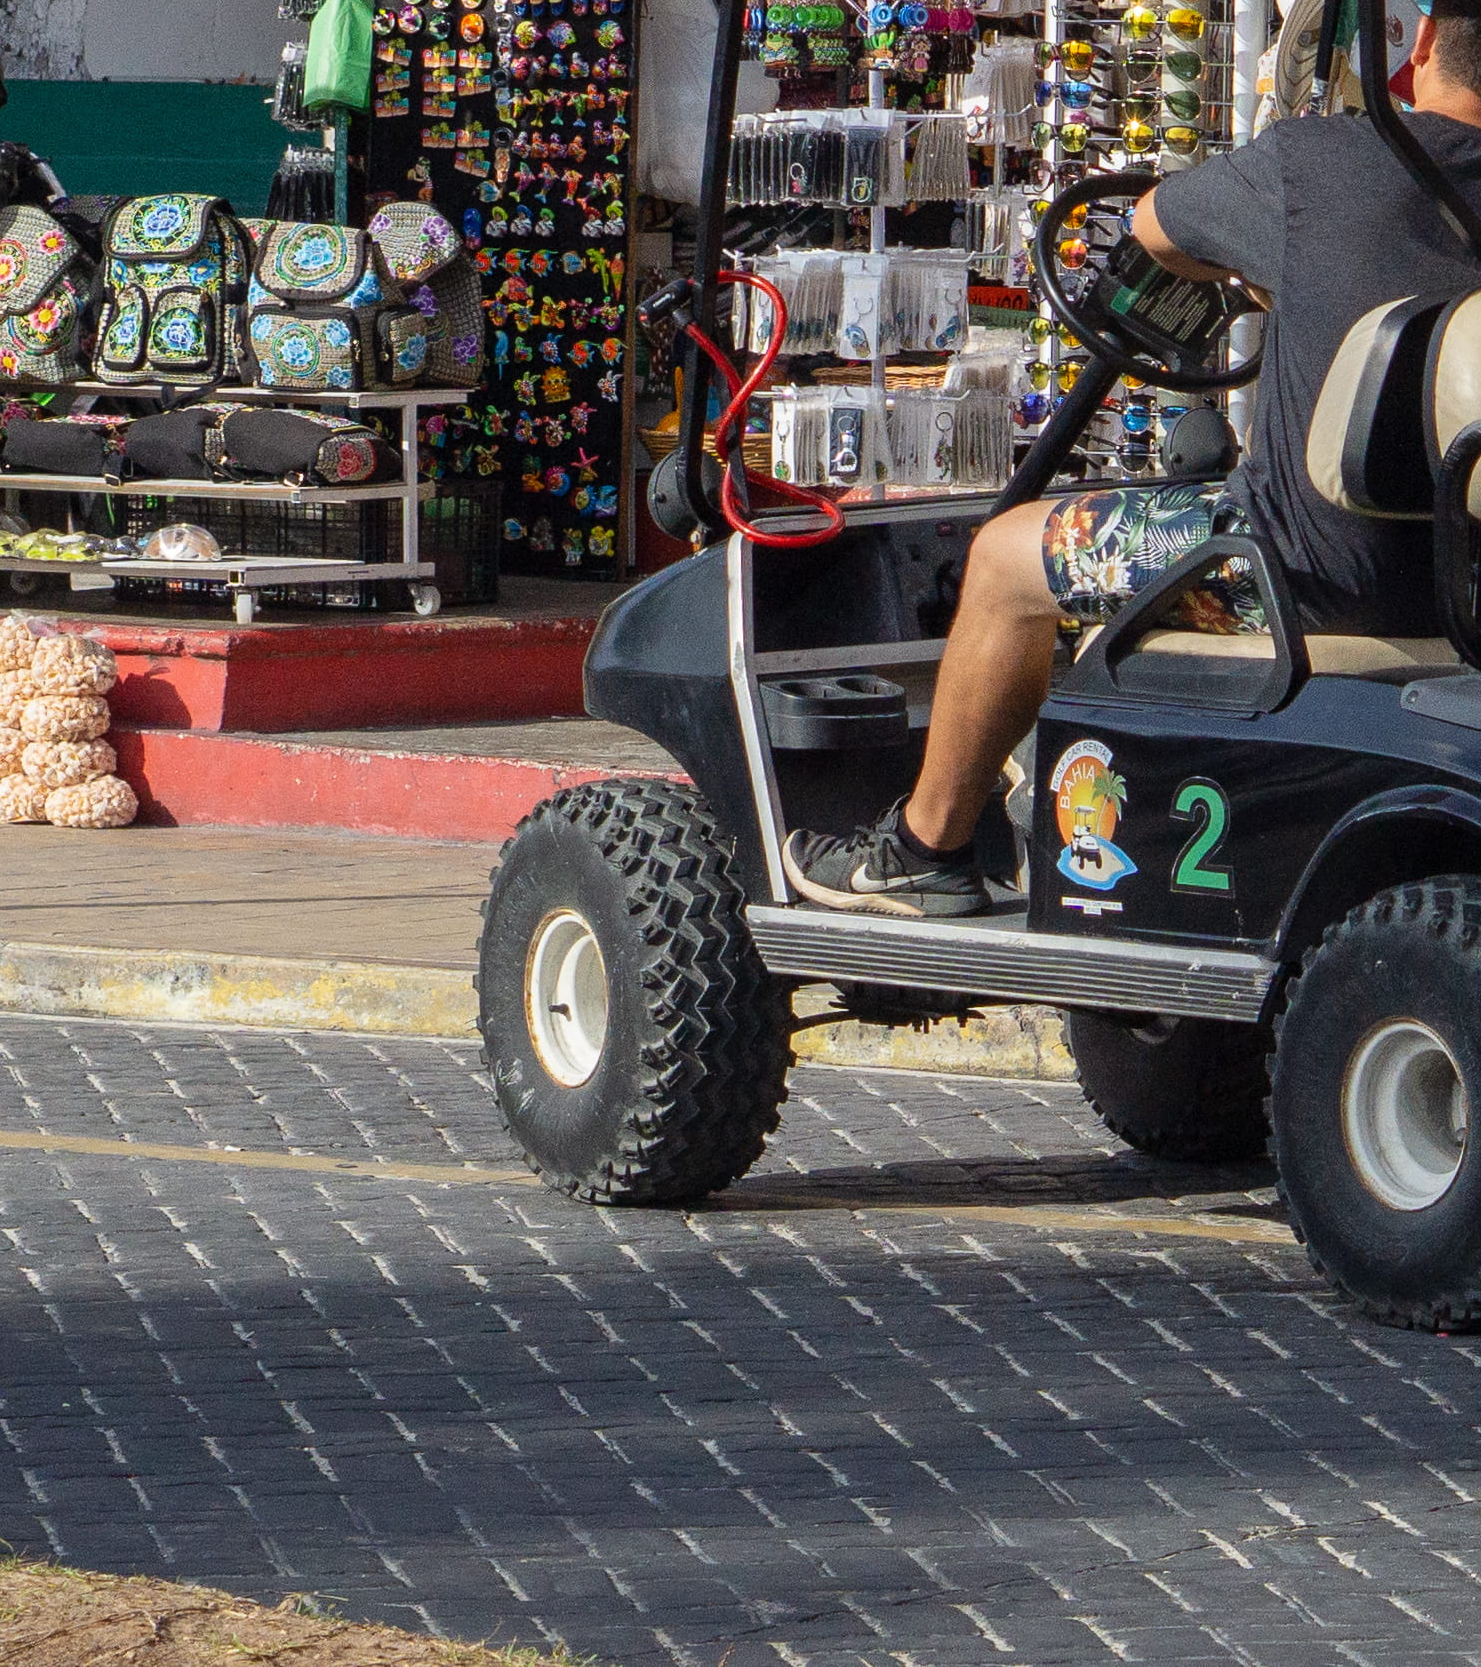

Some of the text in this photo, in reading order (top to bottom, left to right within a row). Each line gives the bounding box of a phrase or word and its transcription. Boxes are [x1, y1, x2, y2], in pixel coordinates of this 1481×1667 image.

[1067, 743, 1083, 758] CAR
[1083, 741, 1111, 763] RENTAL
[1059, 762, 1096, 810] BAHIA
[1174, 783, 1231, 891] 2
